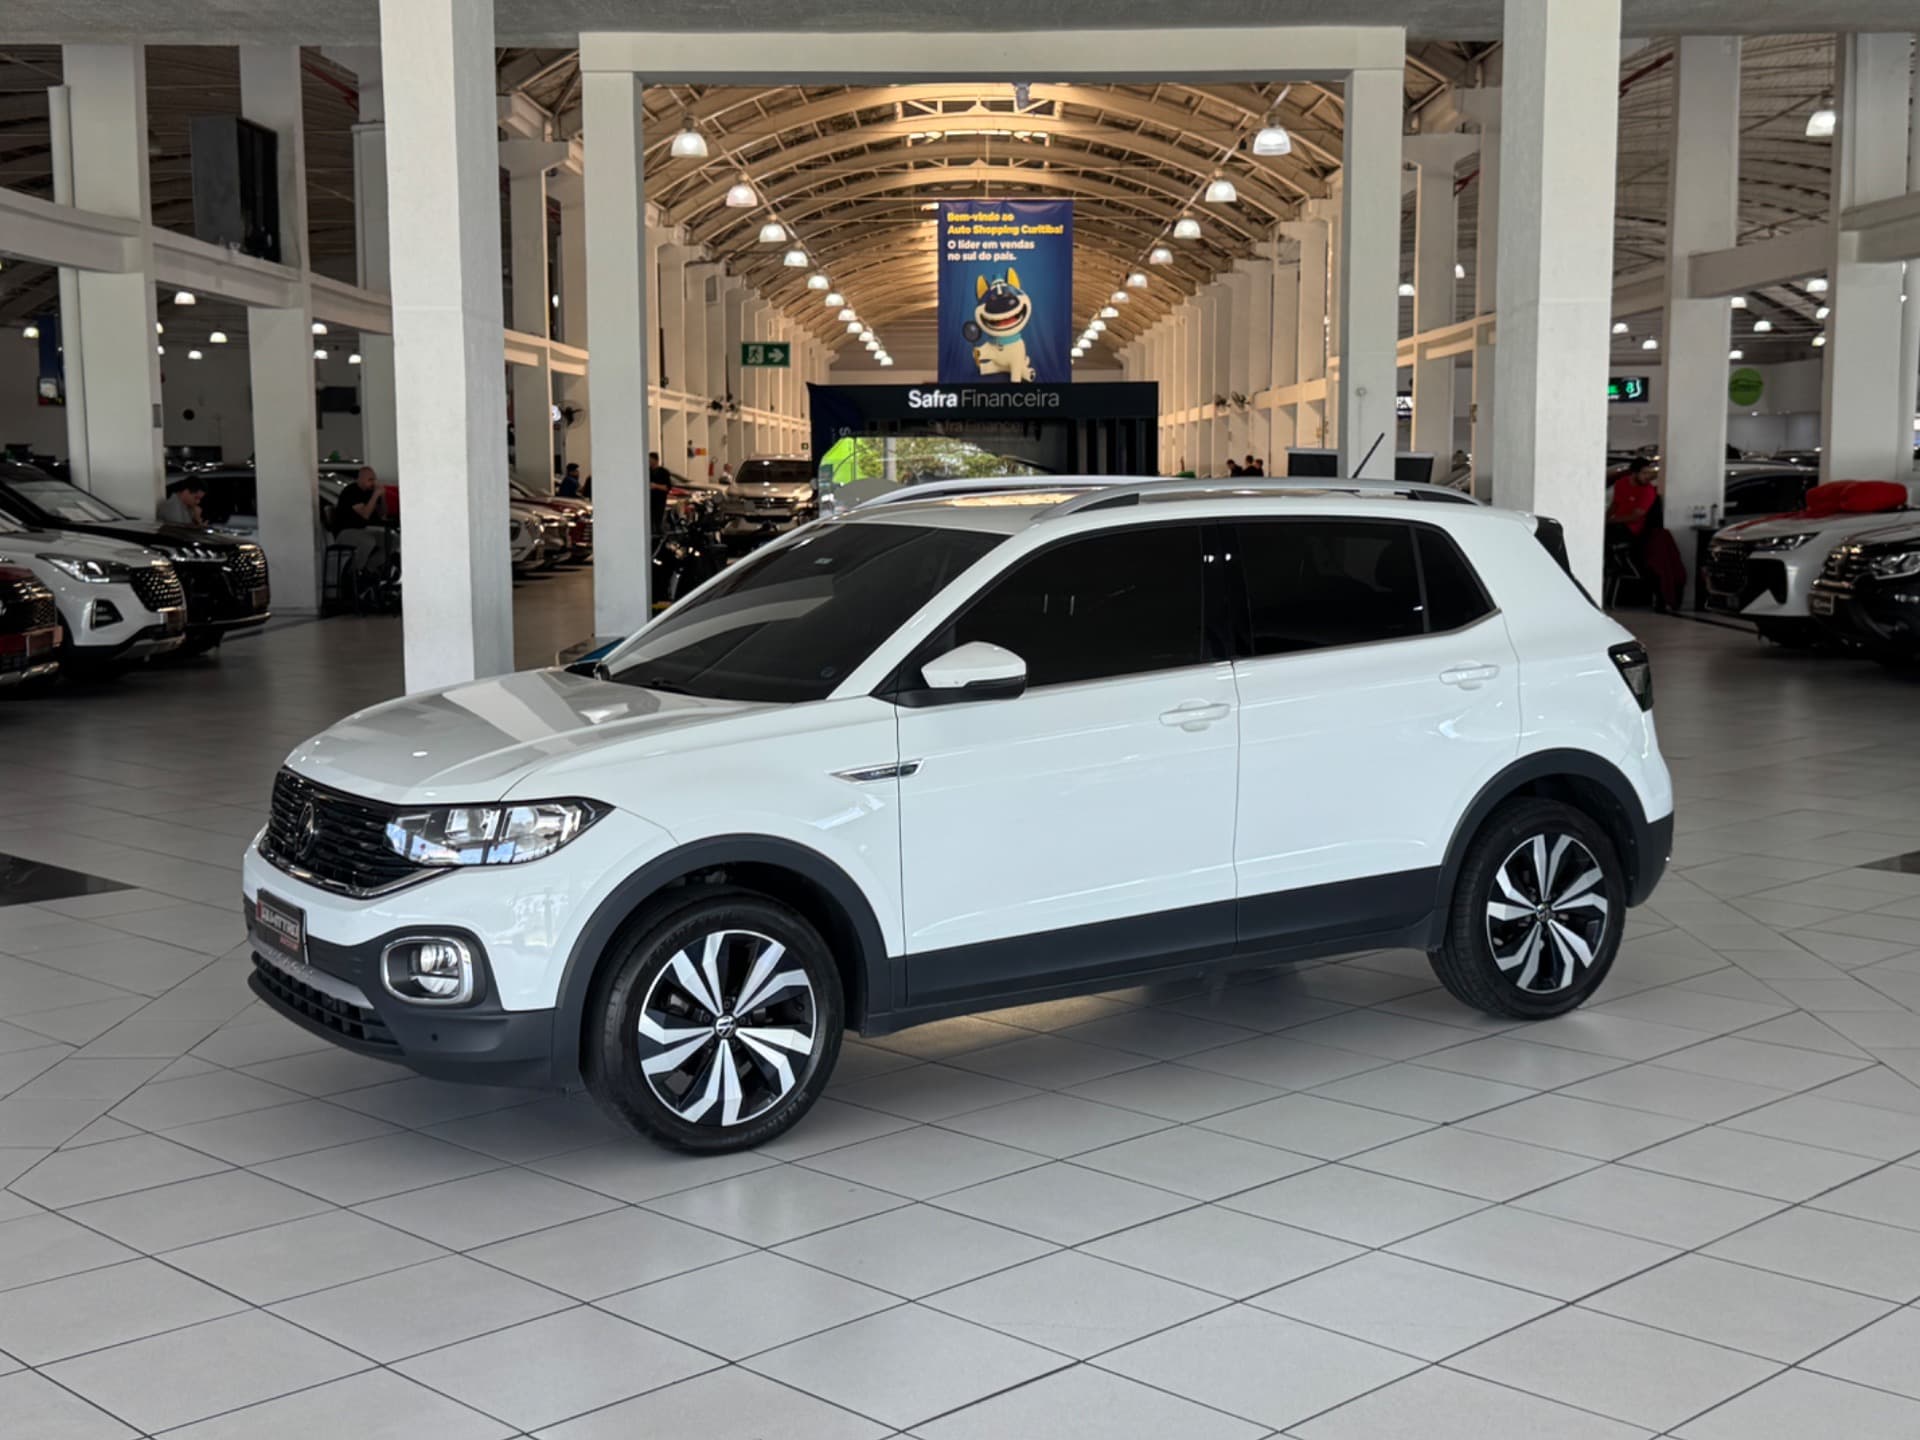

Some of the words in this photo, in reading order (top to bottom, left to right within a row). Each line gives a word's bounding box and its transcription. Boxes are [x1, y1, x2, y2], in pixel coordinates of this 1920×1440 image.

[947, 212, 1000, 222] Bem-vindo
[1001, 213, 1015, 222] ao
[947, 225, 971, 234] Auto
[973, 225, 1019, 236] Shopping
[1021, 225, 1064, 234] Curitiba!
[947, 240, 956, 249] O
[982, 241, 998, 249] em
[1000, 239, 1035, 249] vendas
[947, 252, 960, 260] no
[962, 251, 977, 260] sul
[978, 251, 992, 260] do
[908, 389, 958, 408] Safra
[961, 389, 1060, 408] Financeira
